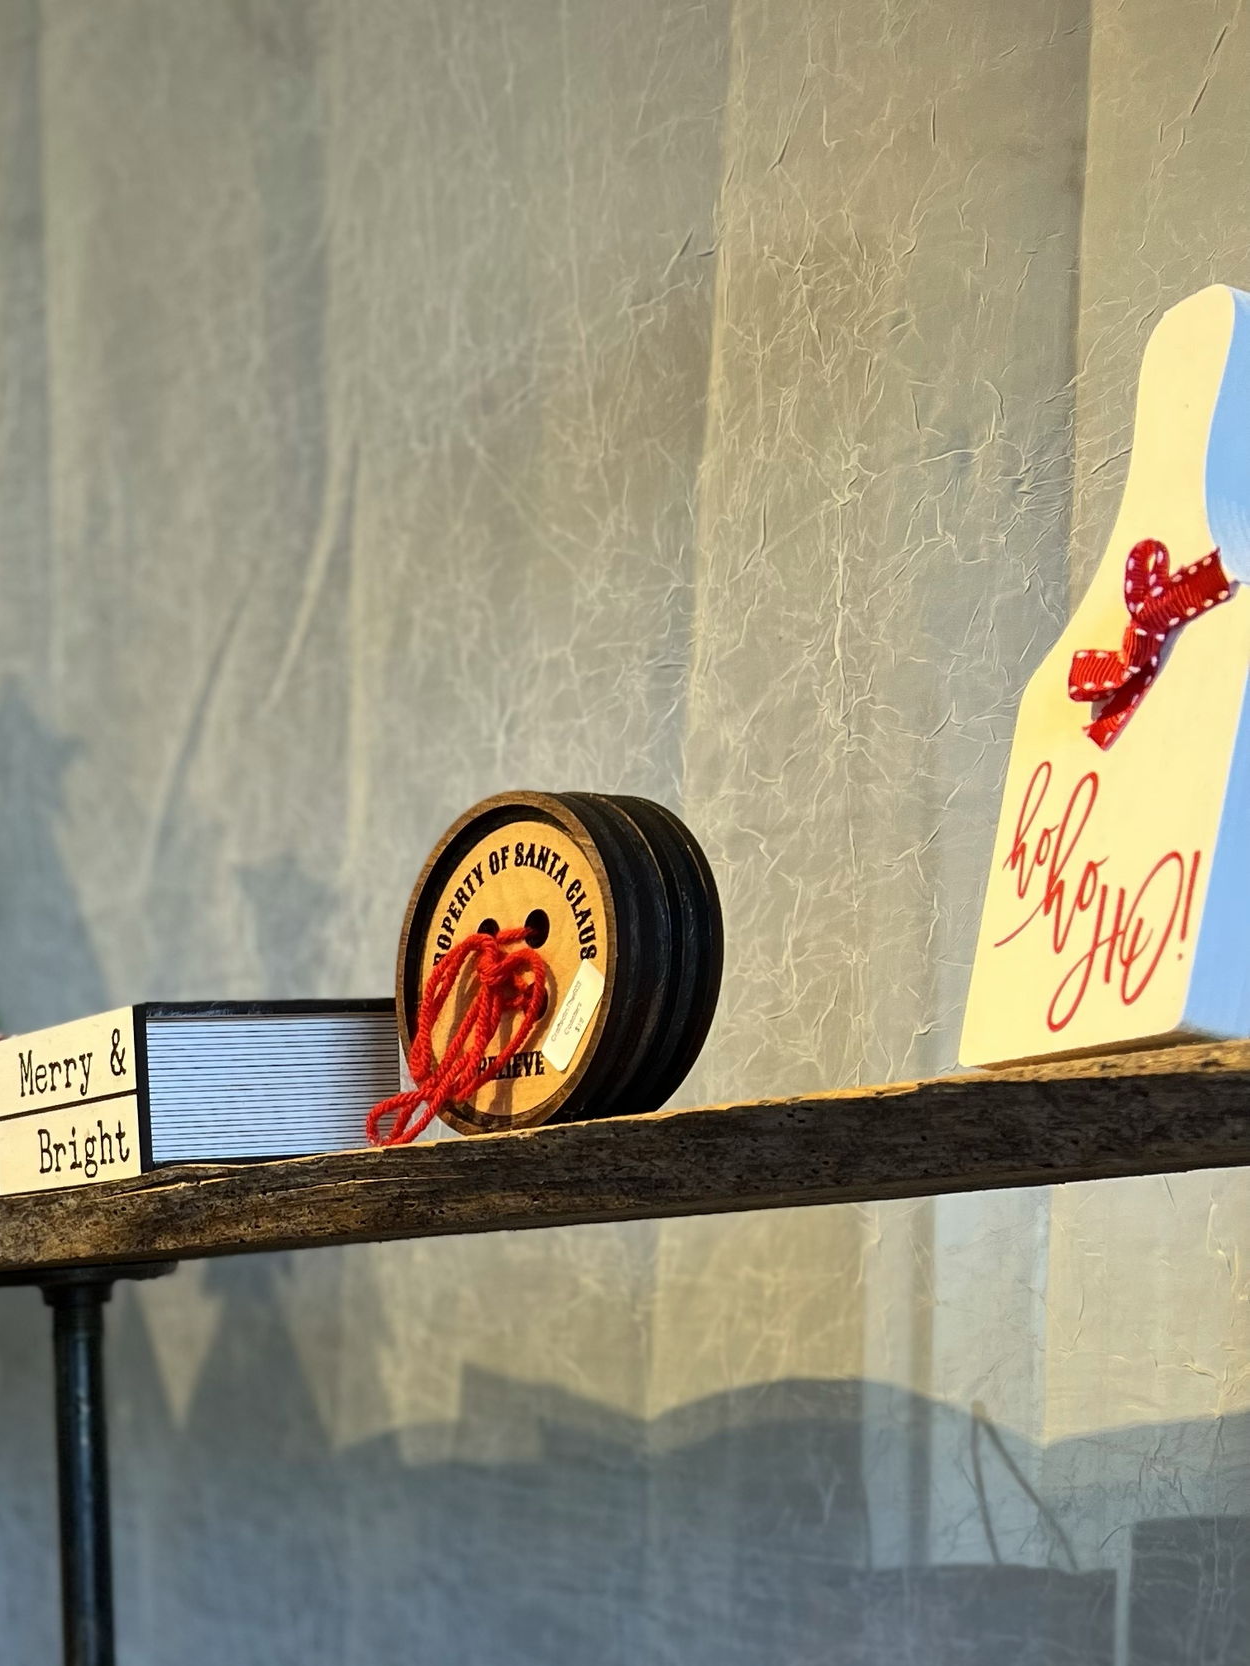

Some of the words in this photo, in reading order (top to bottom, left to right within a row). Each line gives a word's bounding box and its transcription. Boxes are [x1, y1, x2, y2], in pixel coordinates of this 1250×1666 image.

[488, 845, 510, 875] OF
[514, 842, 569, 888] SANTA
[565, 879, 597, 960] CLAUS
[18, 1049, 93, 1097] Merry
[110, 1028, 127, 1077] &
[37, 1119, 130, 1178] Bright
